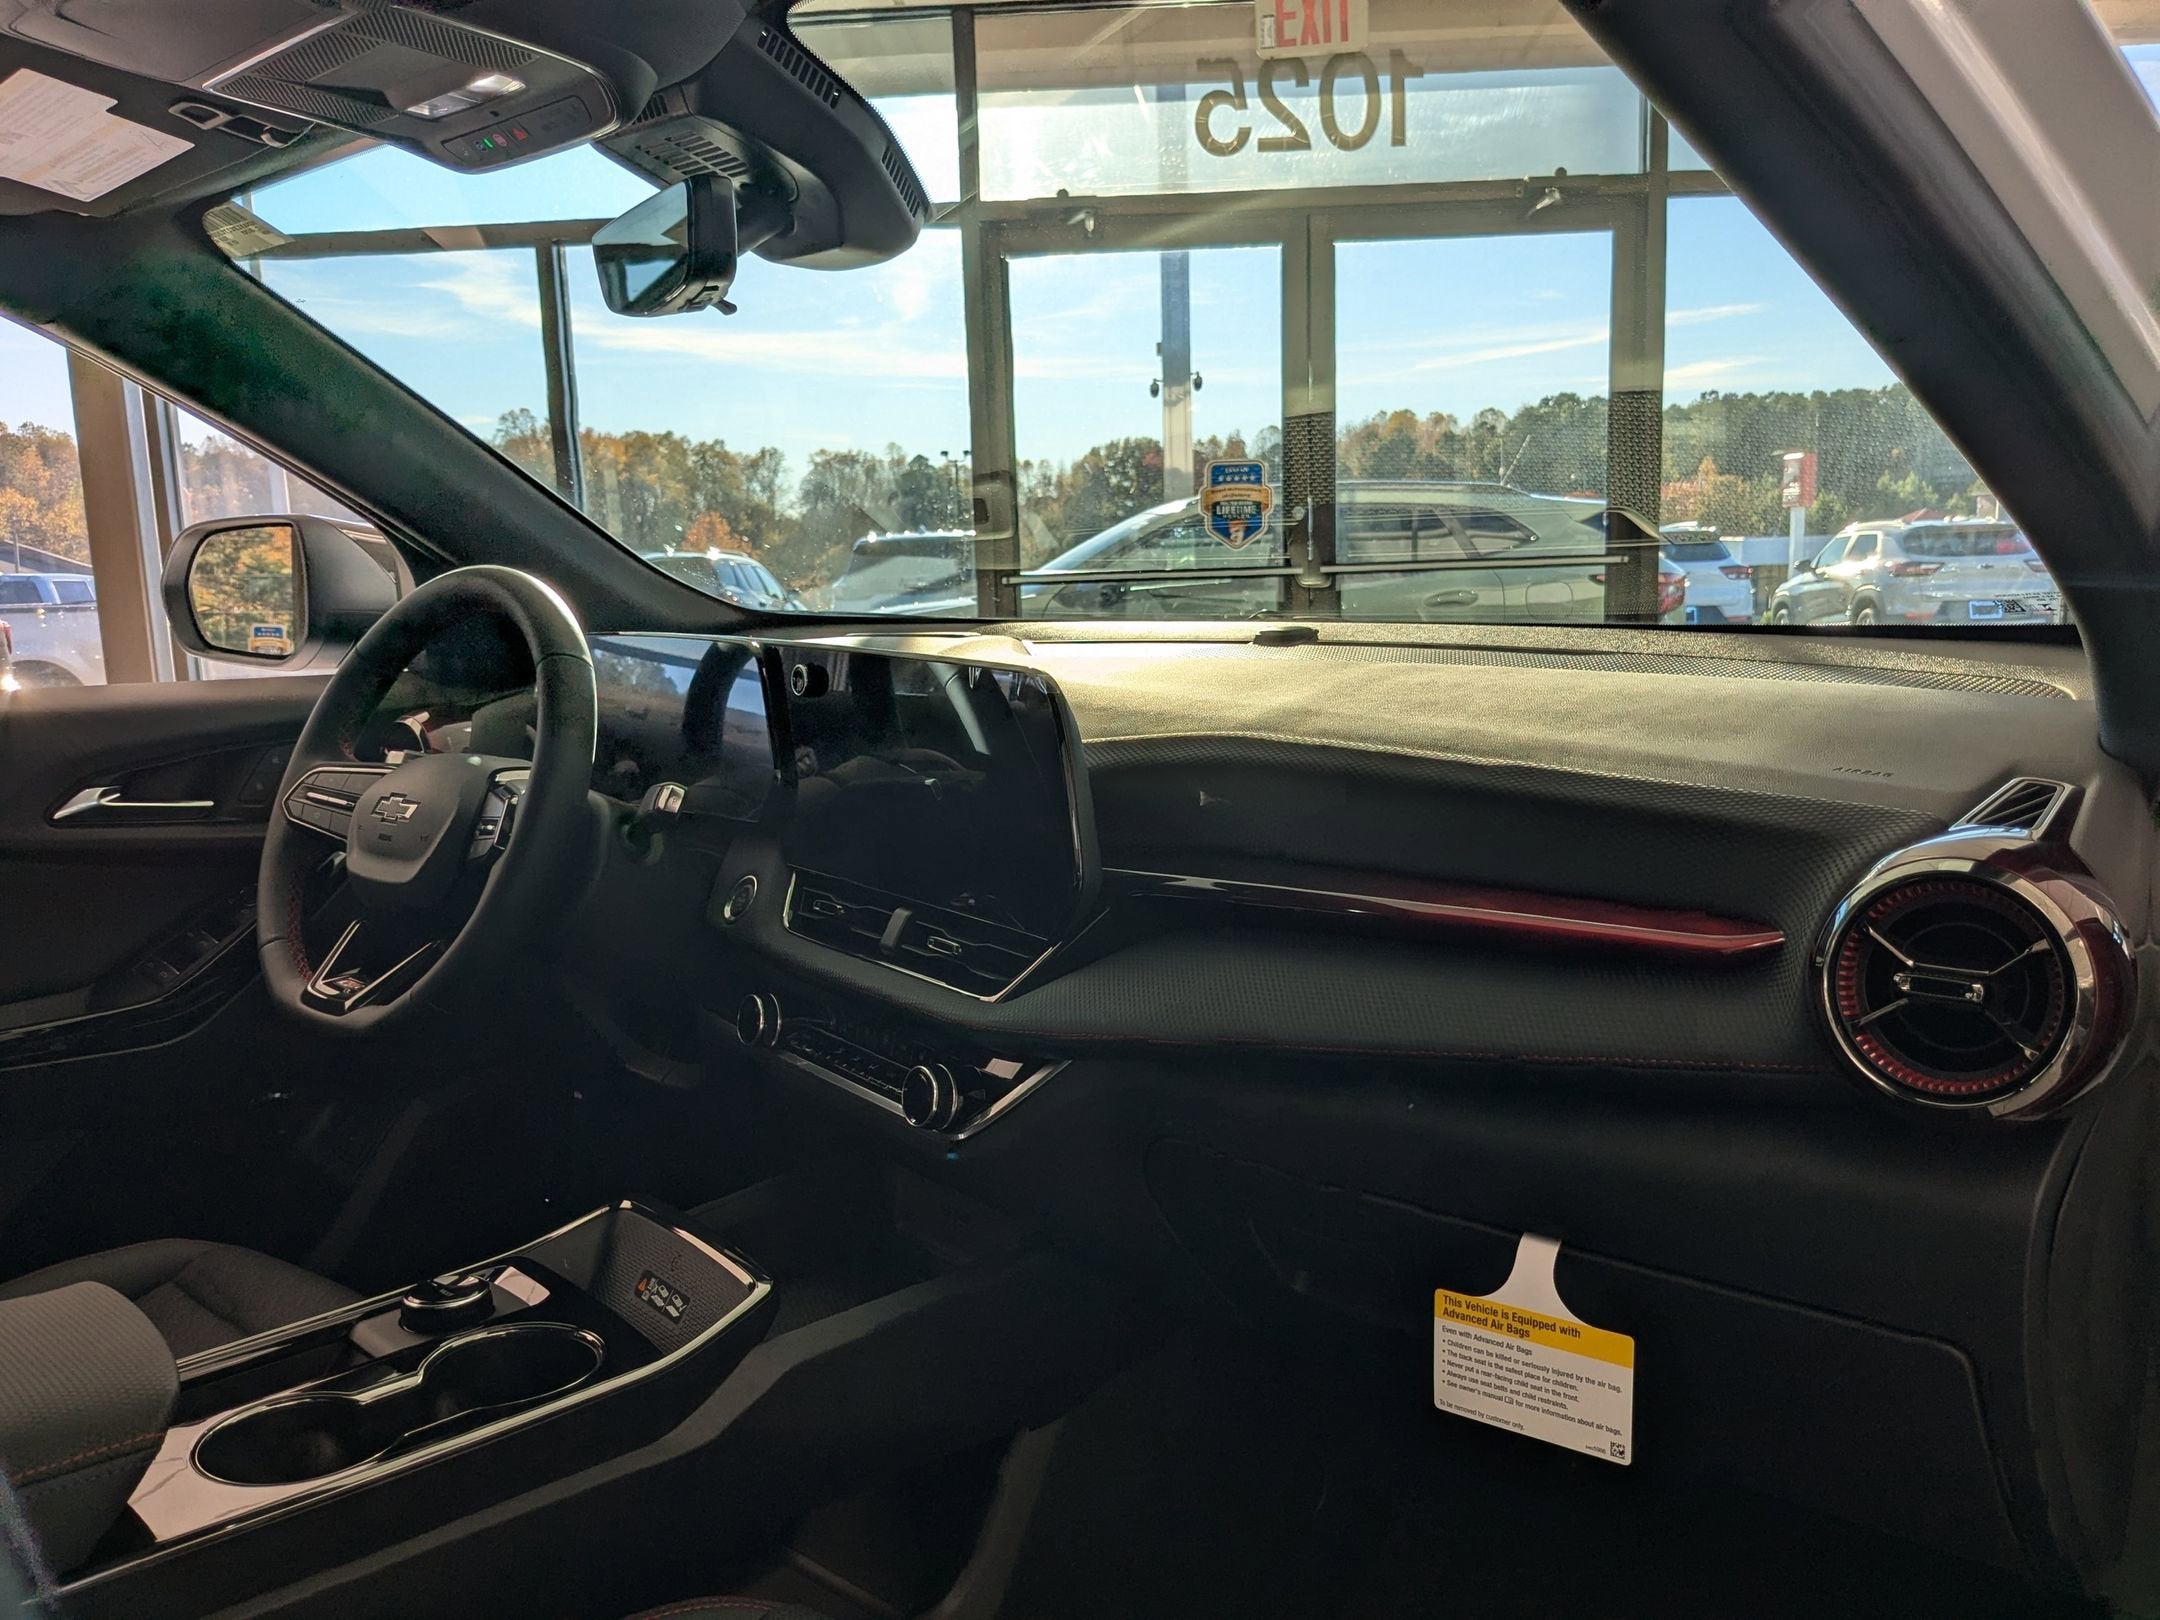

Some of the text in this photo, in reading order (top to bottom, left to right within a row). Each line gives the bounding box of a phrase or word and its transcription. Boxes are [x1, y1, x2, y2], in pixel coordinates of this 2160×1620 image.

[1216, 505, 1257, 515] LIFETIME
[1442, 1308, 1530, 1338] Advanced Air Bags
[1443, 1295, 1581, 1338] This Vehicle is Equipped with
[1442, 1325, 1532, 1356] Even with Advanced Air Bags
[1447, 1340, 1472, 1351] Children
[1495, 1353, 1512, 1362] killed
[1521, 1361, 1550, 1374] seriously
[1551, 1368, 1574, 1379] injured
[1575, 1374, 1583, 1383] by
[1585, 1377, 1595, 1385] the
[1608, 1383, 1622, 1393] bag.
